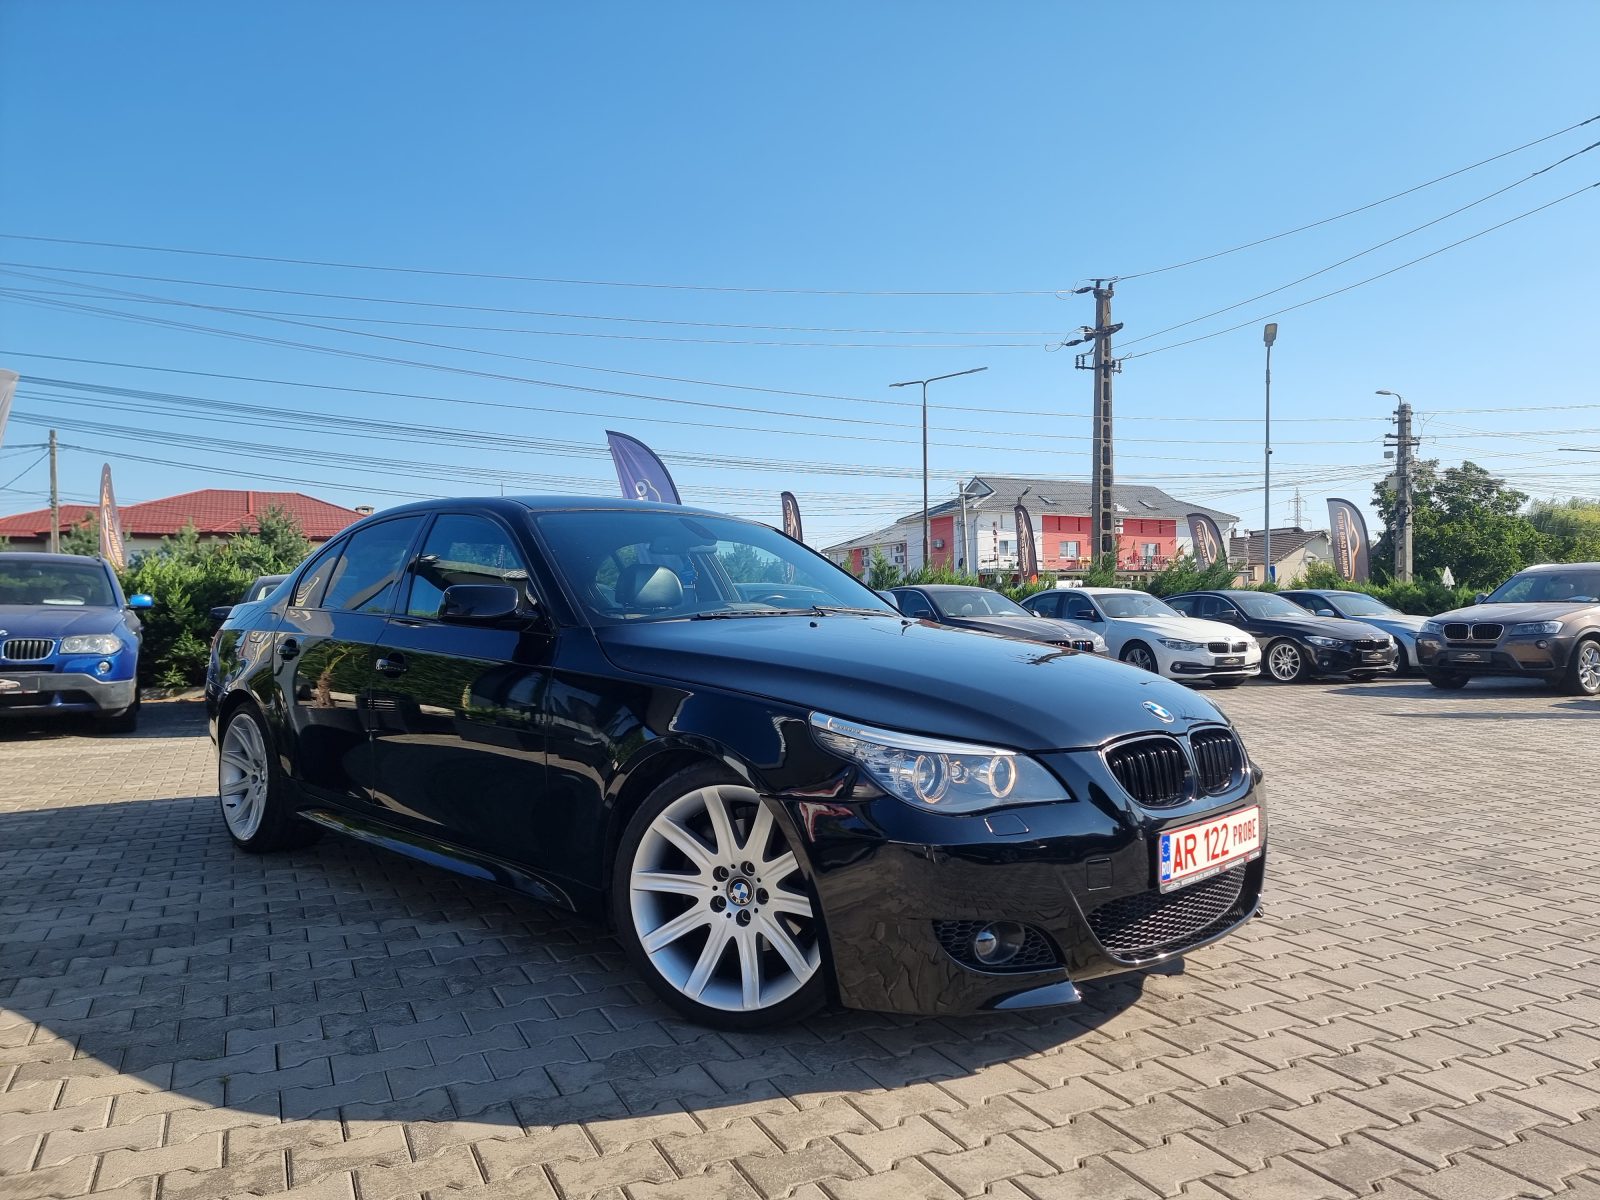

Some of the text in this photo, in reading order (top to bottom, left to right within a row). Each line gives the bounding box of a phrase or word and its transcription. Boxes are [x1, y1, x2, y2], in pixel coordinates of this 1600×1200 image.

[1173, 833, 1197, 873] AR
[1204, 823, 1229, 862] 122
[1233, 818, 1256, 846] PROBE
[1162, 861, 1170, 875] RO
